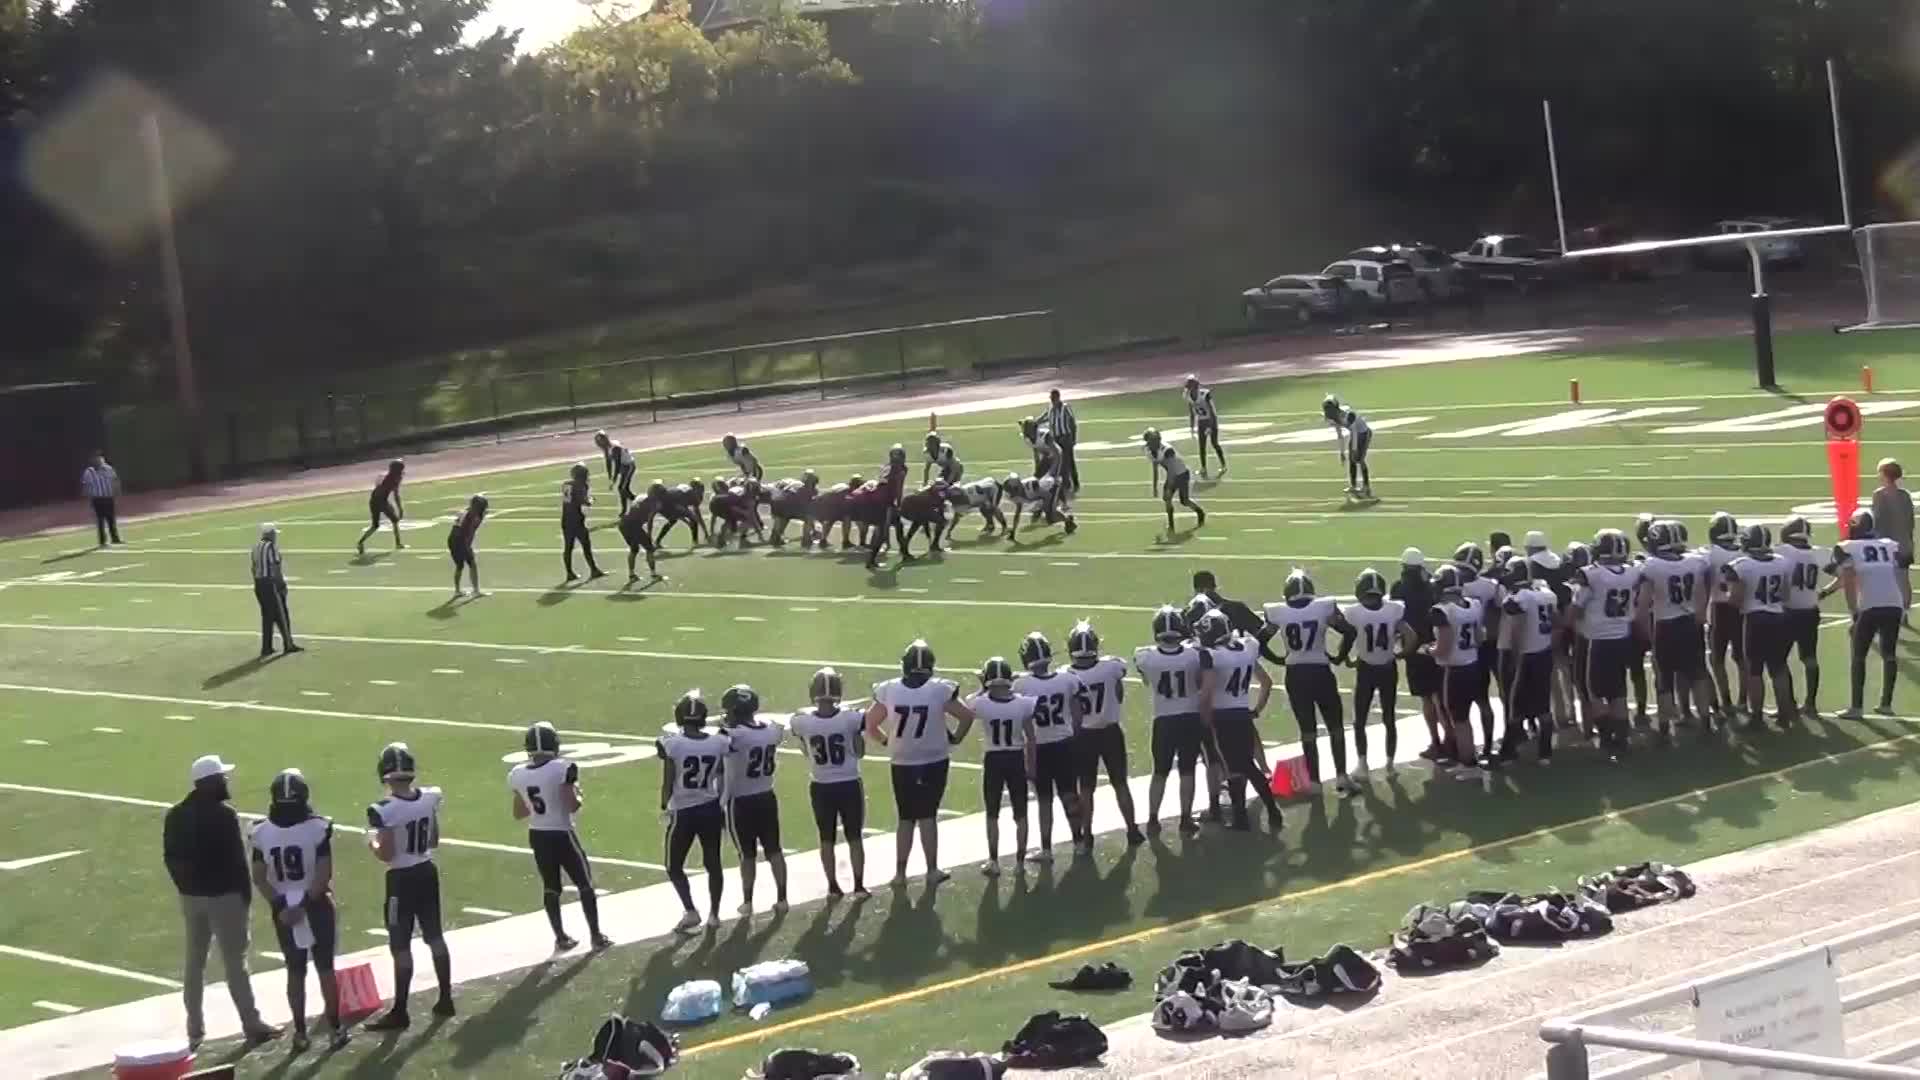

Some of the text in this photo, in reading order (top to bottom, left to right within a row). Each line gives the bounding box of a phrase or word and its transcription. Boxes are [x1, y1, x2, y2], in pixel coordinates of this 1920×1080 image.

[1363, 623, 1389, 651] 14
[1156, 669, 1186, 699] 41
[894, 704, 930, 739] 77
[989, 718, 1013, 747] 11
[809, 732, 846, 766] 36
[682, 755, 717, 789] 27
[526, 785, 546, 815] 5
[269, 844, 306, 882] 19
